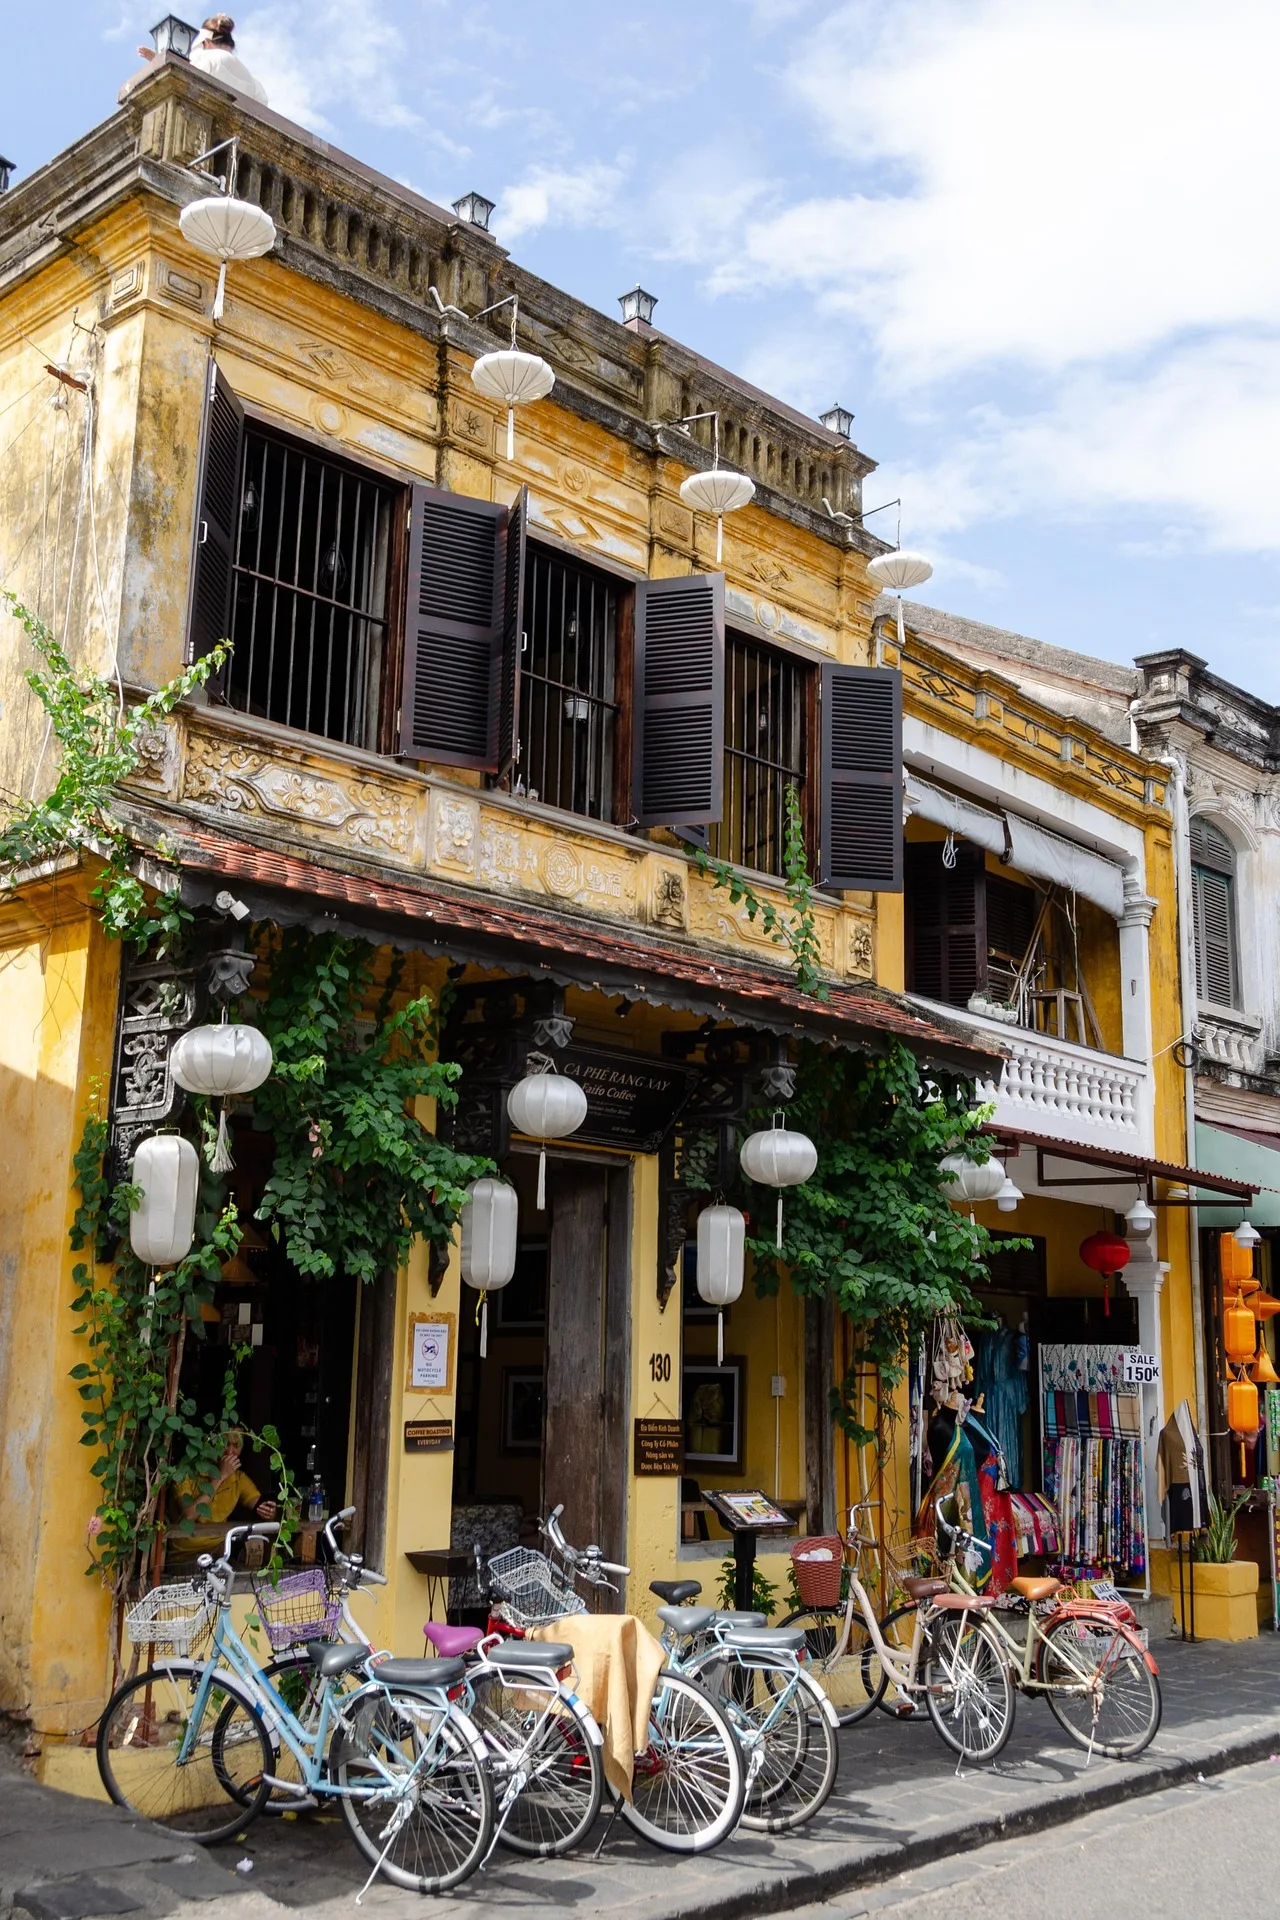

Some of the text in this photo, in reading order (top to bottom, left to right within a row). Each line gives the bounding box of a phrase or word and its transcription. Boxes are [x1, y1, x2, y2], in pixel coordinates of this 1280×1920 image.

[608, 1072, 646, 1087] RANG
[645, 1078, 671, 1092] XAY
[581, 1082, 637, 1101] Faifo Coffee
[649, 1353, 671, 1382] 130
[1130, 1354, 1155, 1365] SALE
[1126, 1366, 1160, 1382] 150K
[1094, 1582, 1112, 1594] SALE
